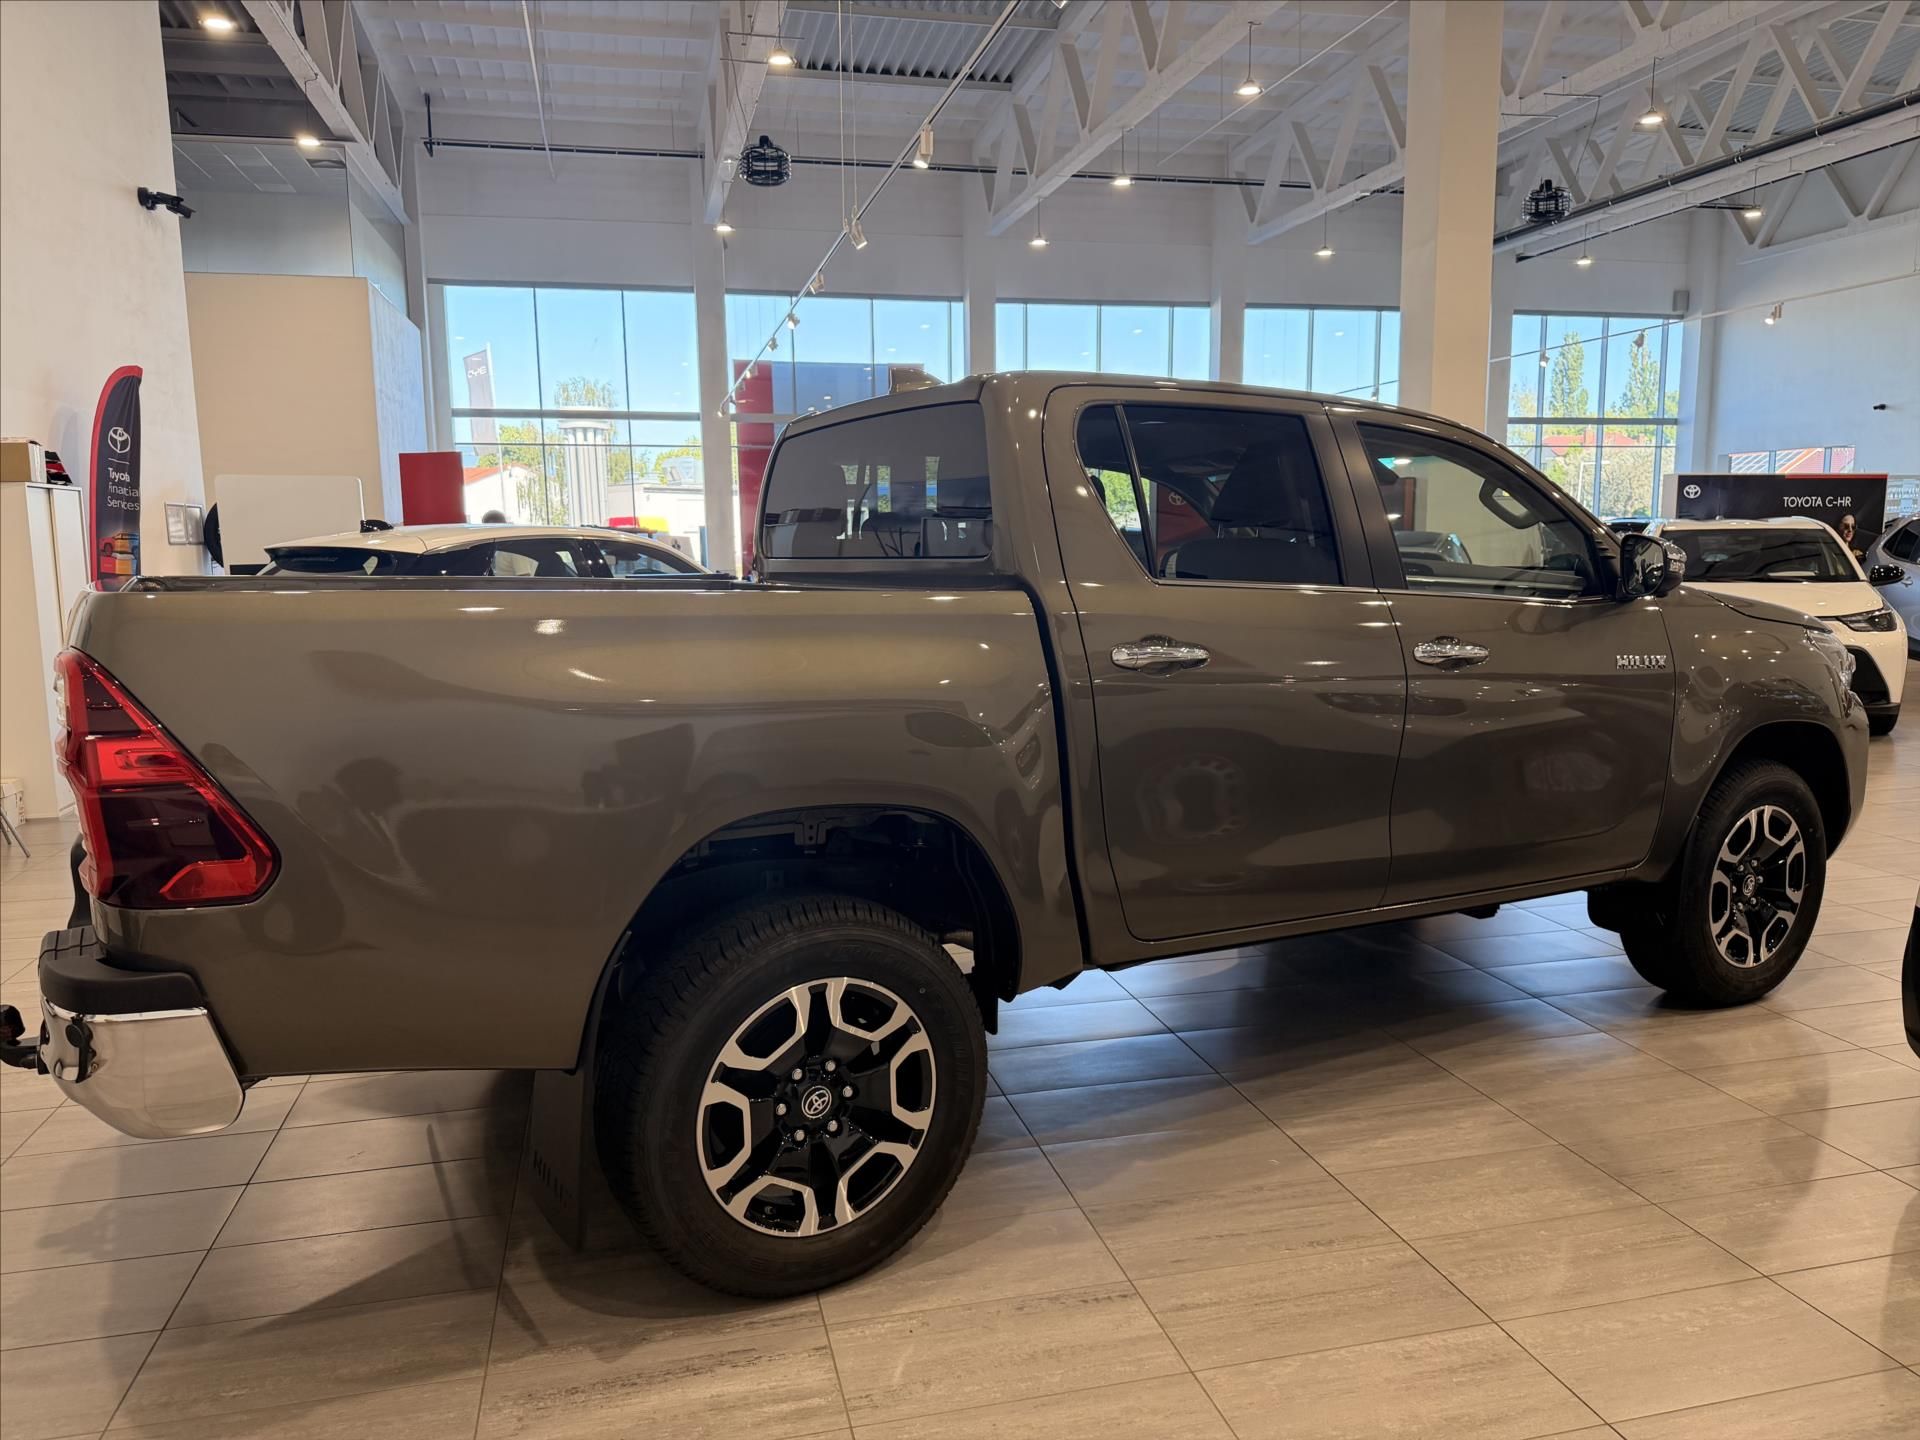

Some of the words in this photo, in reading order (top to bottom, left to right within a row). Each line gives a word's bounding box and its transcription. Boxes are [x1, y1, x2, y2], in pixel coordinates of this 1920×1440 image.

[1783, 496, 1823, 508] TOYOTA
[1825, 496, 1852, 508] C-HR
[1616, 654, 1667, 669] HILUX
